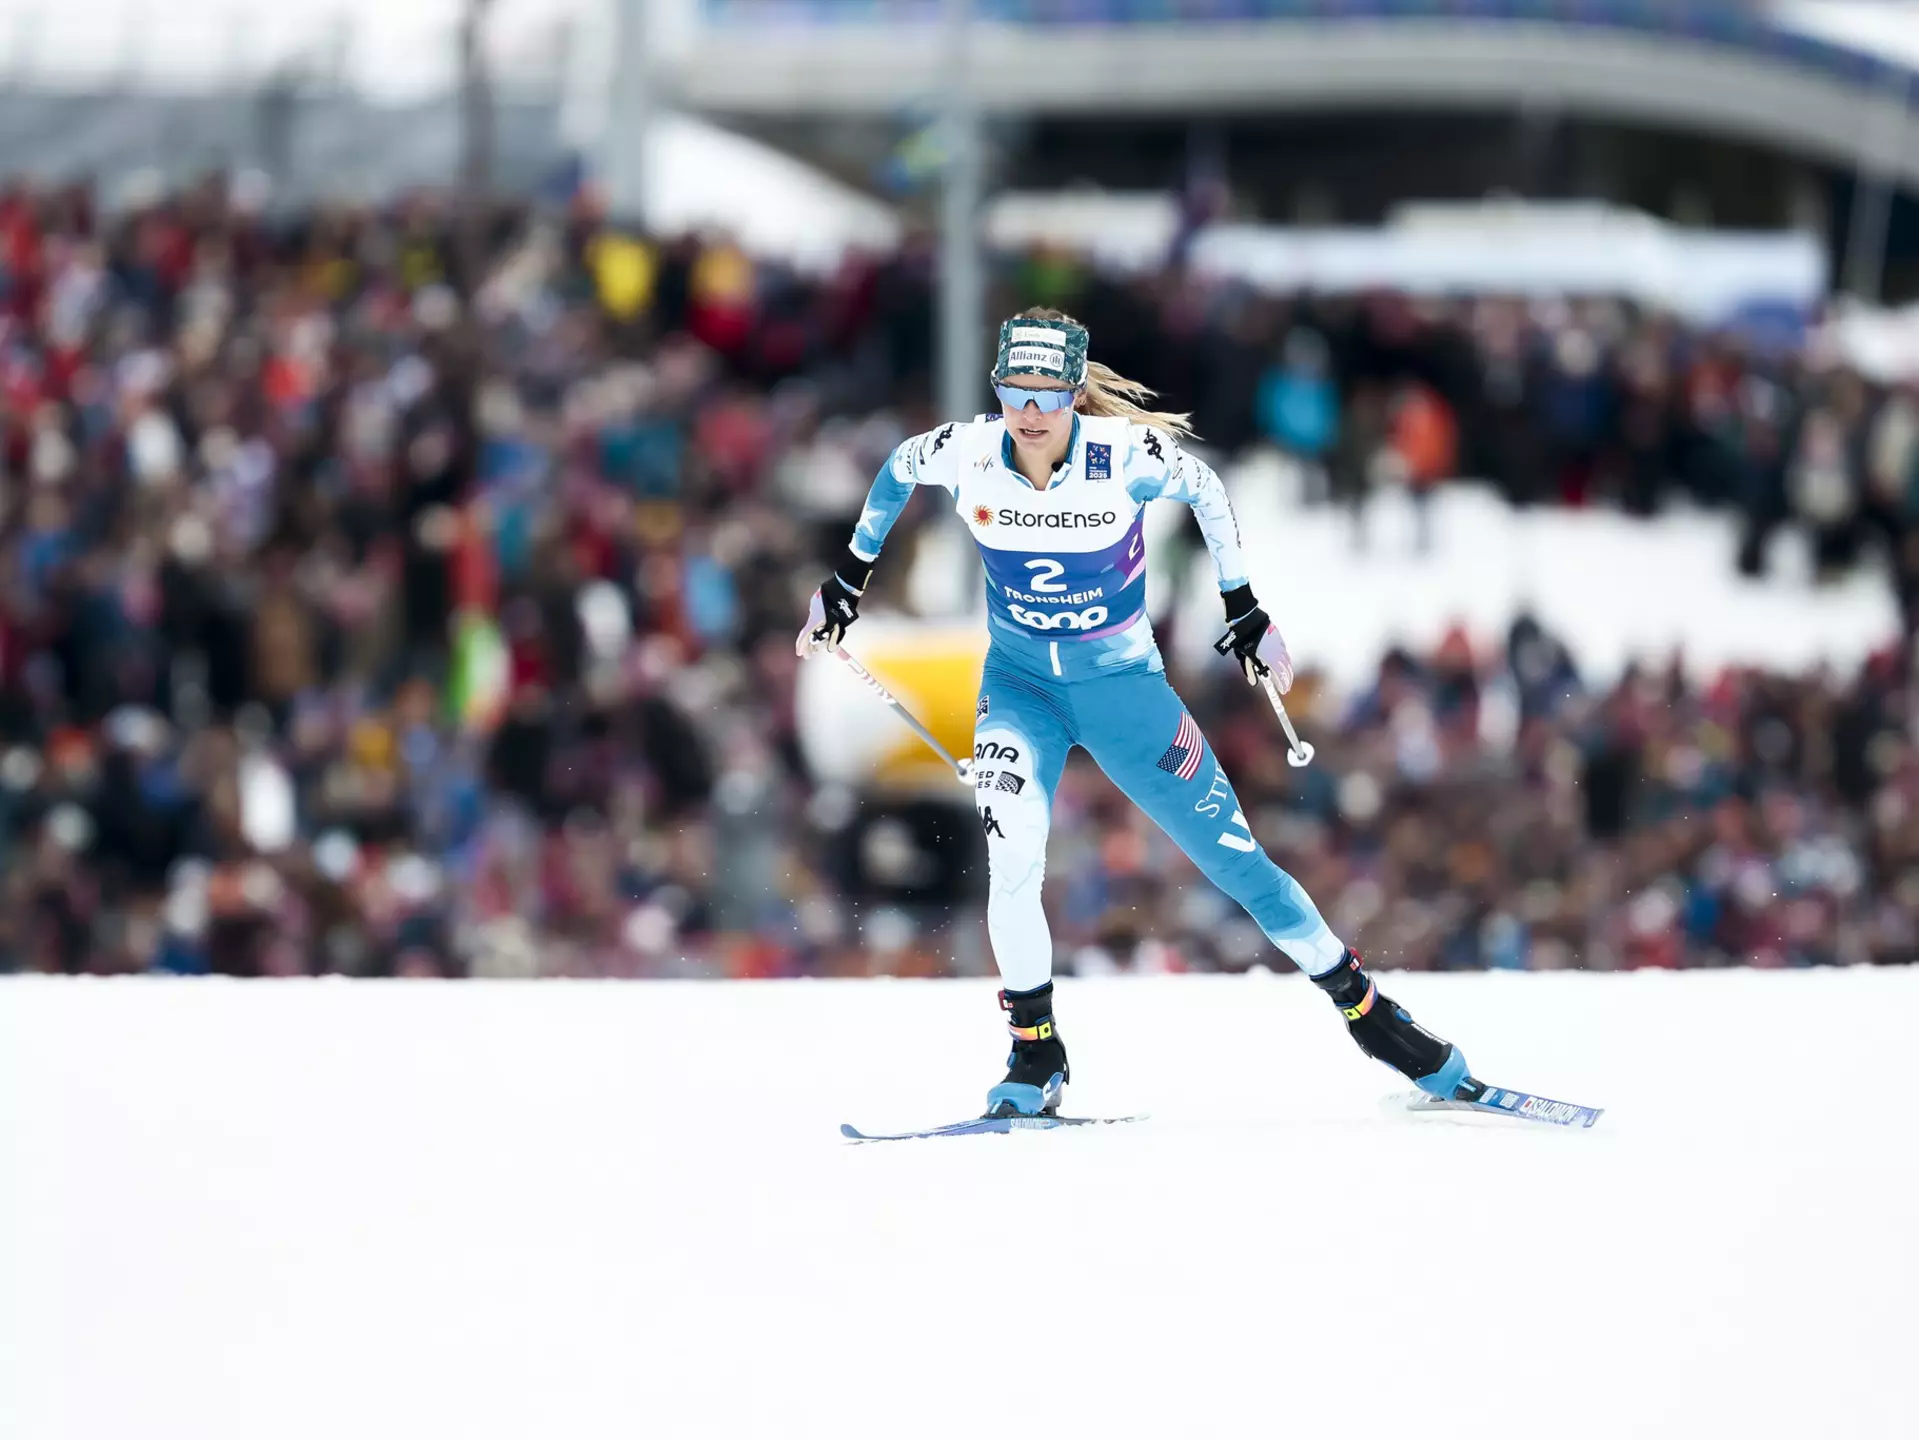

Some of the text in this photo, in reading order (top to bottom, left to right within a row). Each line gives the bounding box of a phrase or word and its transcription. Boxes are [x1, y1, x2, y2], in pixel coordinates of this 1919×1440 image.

[1010, 350, 1048, 362] Allianz
[998, 509, 1116, 528] StoraEnso
[1024, 558, 1068, 593] 2
[1004, 586, 1103, 605] TRONDHEIM
[1007, 604, 1108, 630] coop
[1530, 1098, 1580, 1124] SALOMON
